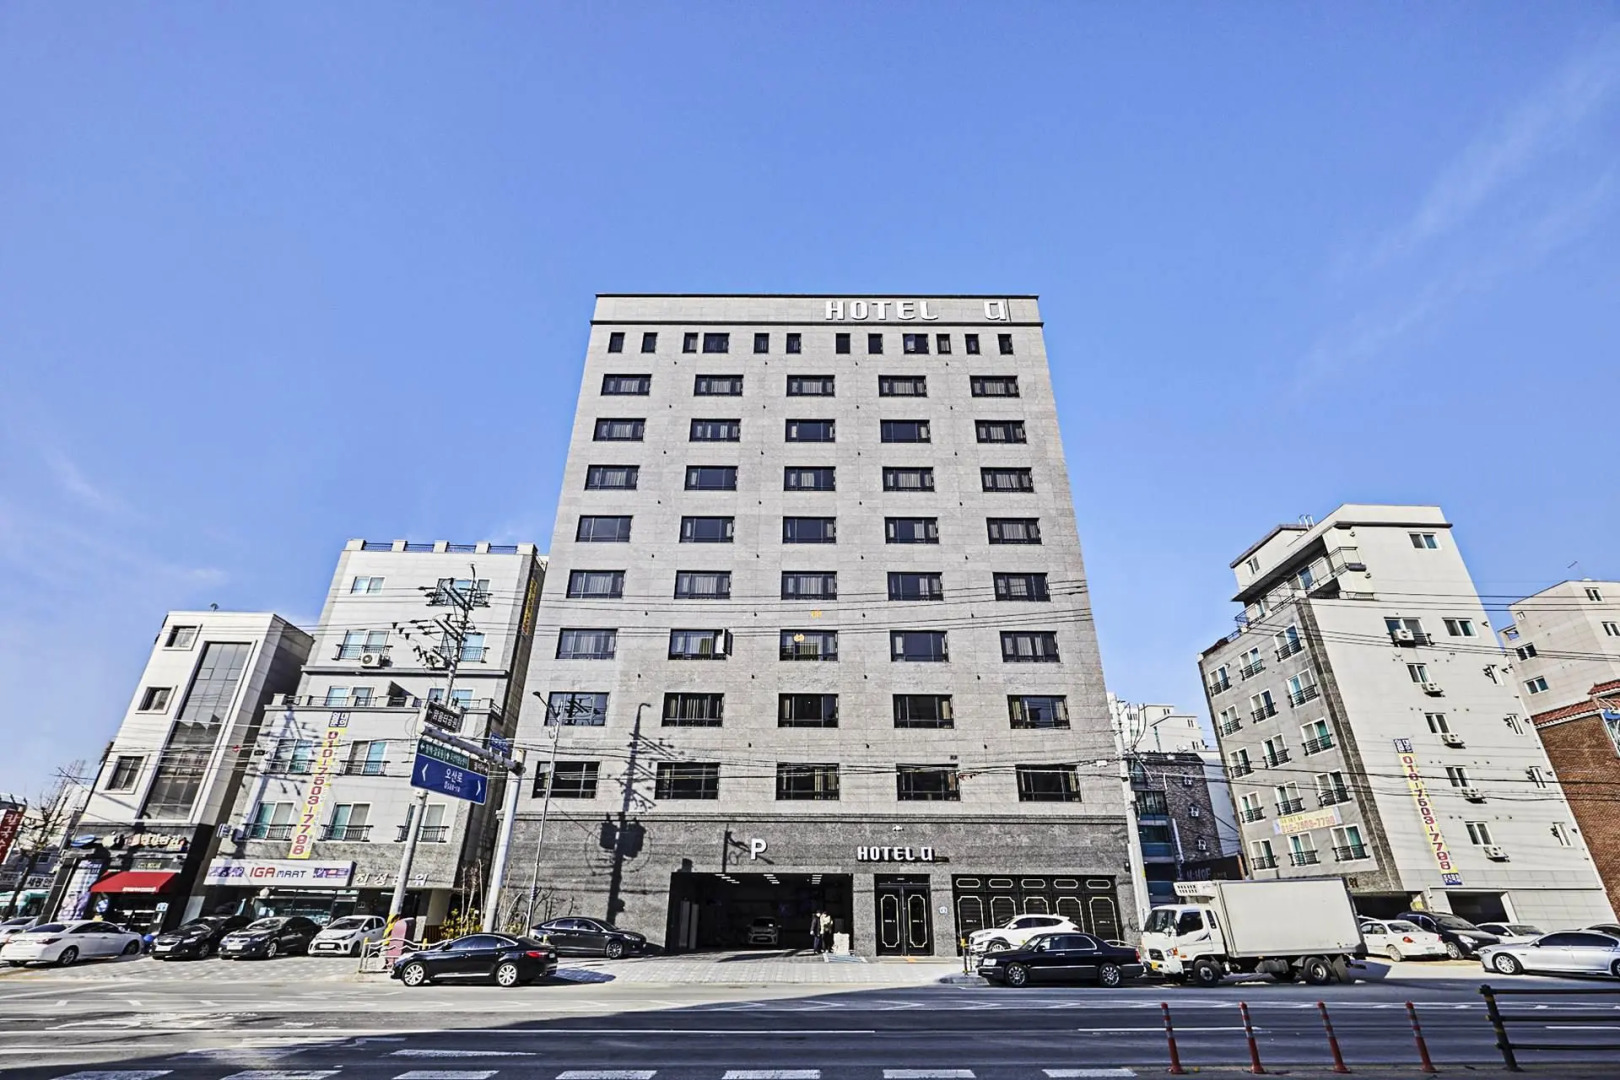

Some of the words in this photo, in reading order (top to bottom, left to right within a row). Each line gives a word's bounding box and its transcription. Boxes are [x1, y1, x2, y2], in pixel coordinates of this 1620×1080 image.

[825, 300, 939, 321] HOTEL
[445, 768, 463, 783] 오산로
[751, 838, 768, 860] P
[857, 846, 916, 861] HOTEL
[250, 867, 275, 878] IGA
